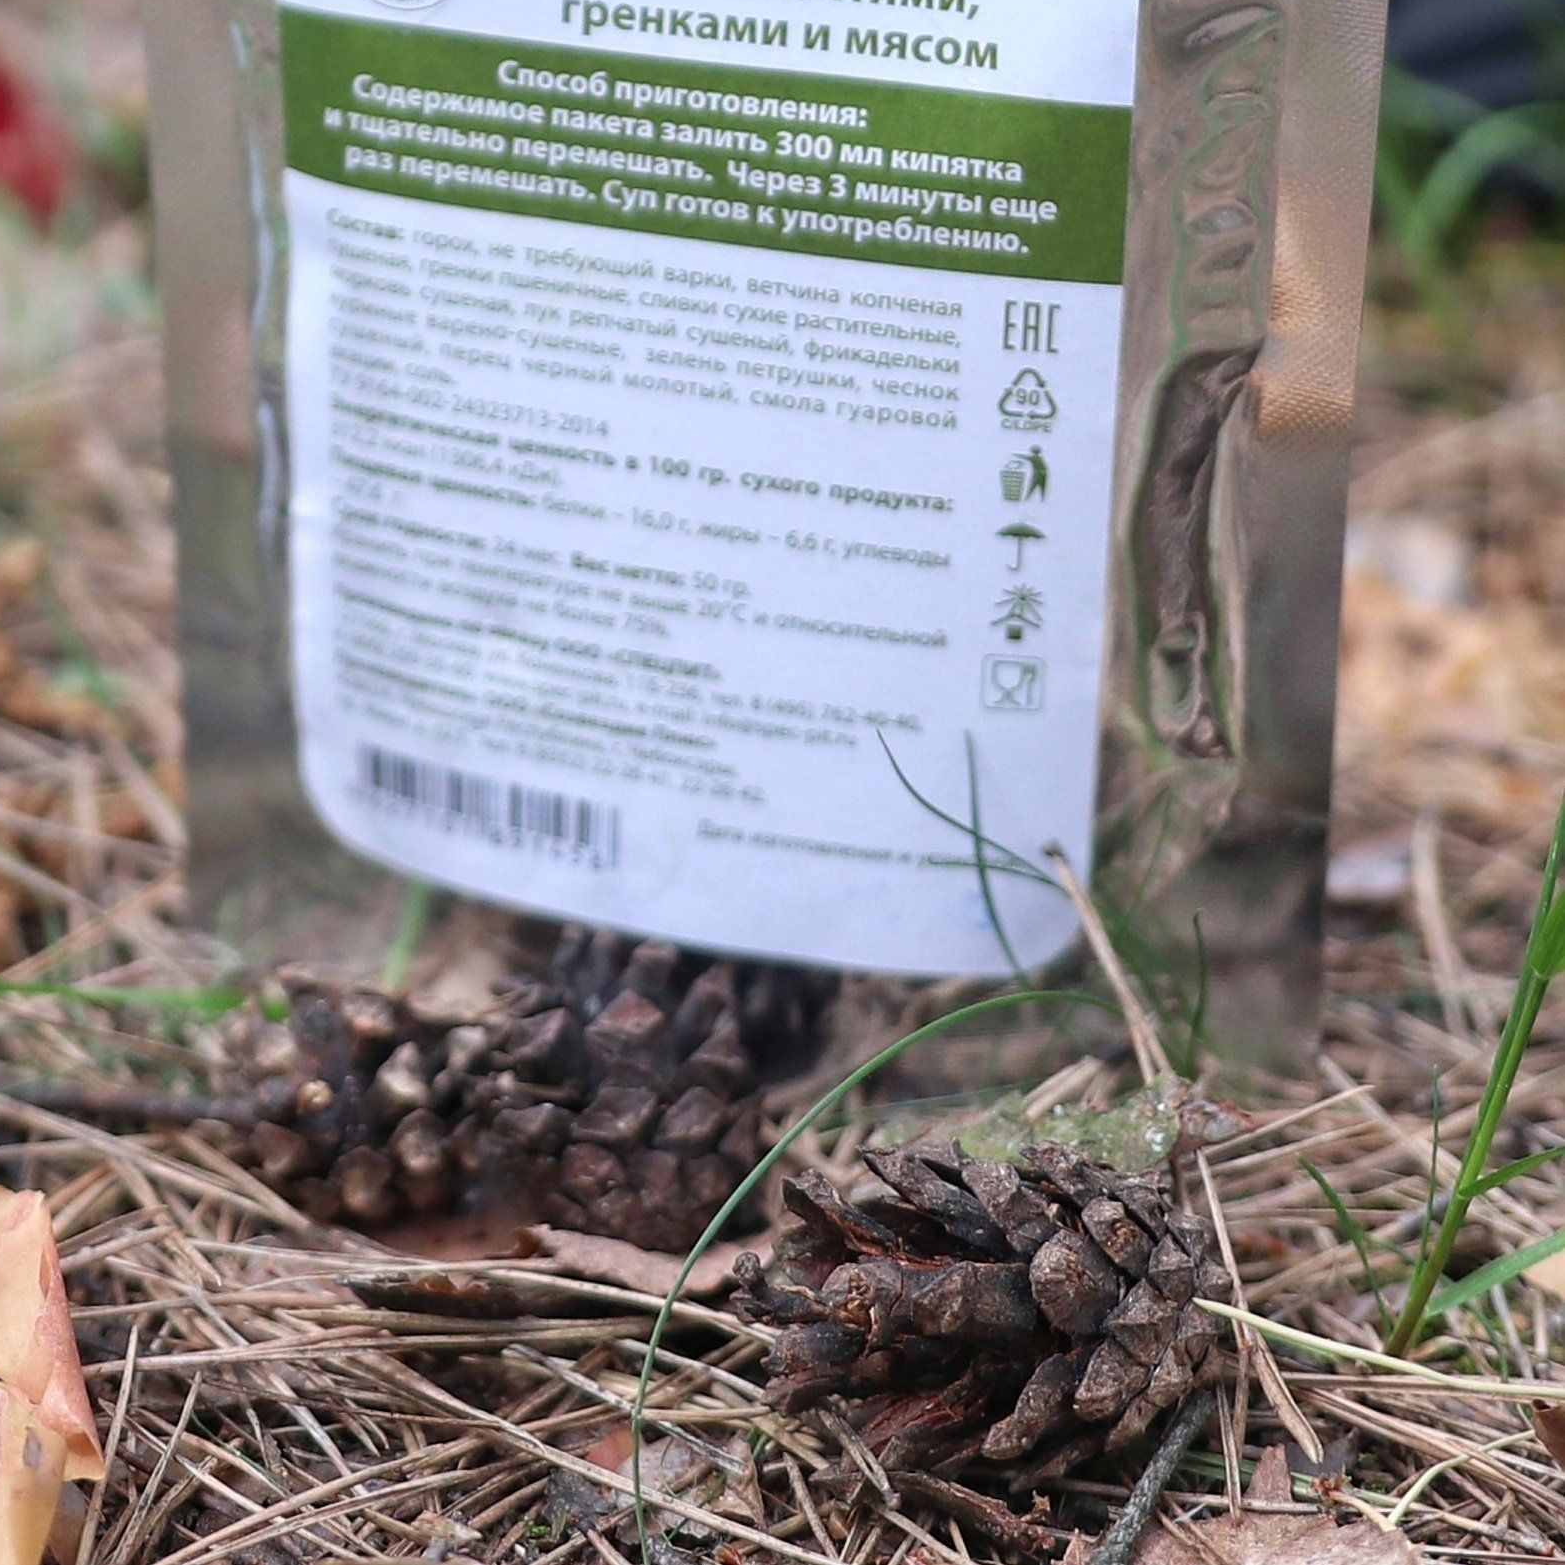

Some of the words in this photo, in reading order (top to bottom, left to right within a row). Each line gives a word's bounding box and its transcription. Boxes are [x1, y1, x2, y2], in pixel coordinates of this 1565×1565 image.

[804, 23, 830, 51] и
[844, 27, 999, 71] мясом
[352, 73, 545, 124] Содержимое
[551, 107, 654, 138] пакета
[660, 121, 768, 153] залить
[775, 130, 833, 160] 300
[839, 143, 883, 167] мл
[890, 148, 1023, 182] кипятка
[497, 59, 609, 97] Способ
[613, 79, 868, 128] приготовления:
[323, 107, 343, 129] и
[347, 111, 505, 154] тщательно
[512, 136, 714, 180] перемешать.
[727, 160, 821, 196] Через
[828, 174, 847, 199] 3
[855, 181, 982, 215] минуты
[990, 197, 1059, 224] еще
[344, 145, 395, 172] раз
[399, 154, 596, 201] перемешать.
[601, 179, 658, 212] Суп
[664, 191, 750, 221] готов
[757, 204, 776, 225] к
[782, 207, 1031, 255] употреблению.
[419, 258, 492, 283] гренки
[499, 271, 631, 306] пшеничные,
[638, 289, 717, 315] сливки
[723, 301, 787, 326] сухие
[794, 312, 961, 348] растительные,
[488, 242, 515, 260] не
[525, 244, 654, 279] требующий
[663, 265, 738, 291] варки,
[746, 276, 841, 305] ветчина
[850, 291, 963, 318] копченая
[569, 309, 676, 340] репчатый
[686, 324, 794, 356] сушеный,
[803, 338, 960, 373] фрикадельки
[645, 346, 726, 373] зелень
[871, 377, 960, 402] чеснок
[522, 356, 613, 384] черный
[749, 388, 826, 414] смола
[836, 401, 958, 429] гуаровой
[649, 455, 691, 477] 100
[739, 471, 820, 496] сухого
[829, 483, 953, 512] продукта:
[842, 539, 951, 568] углеводы
